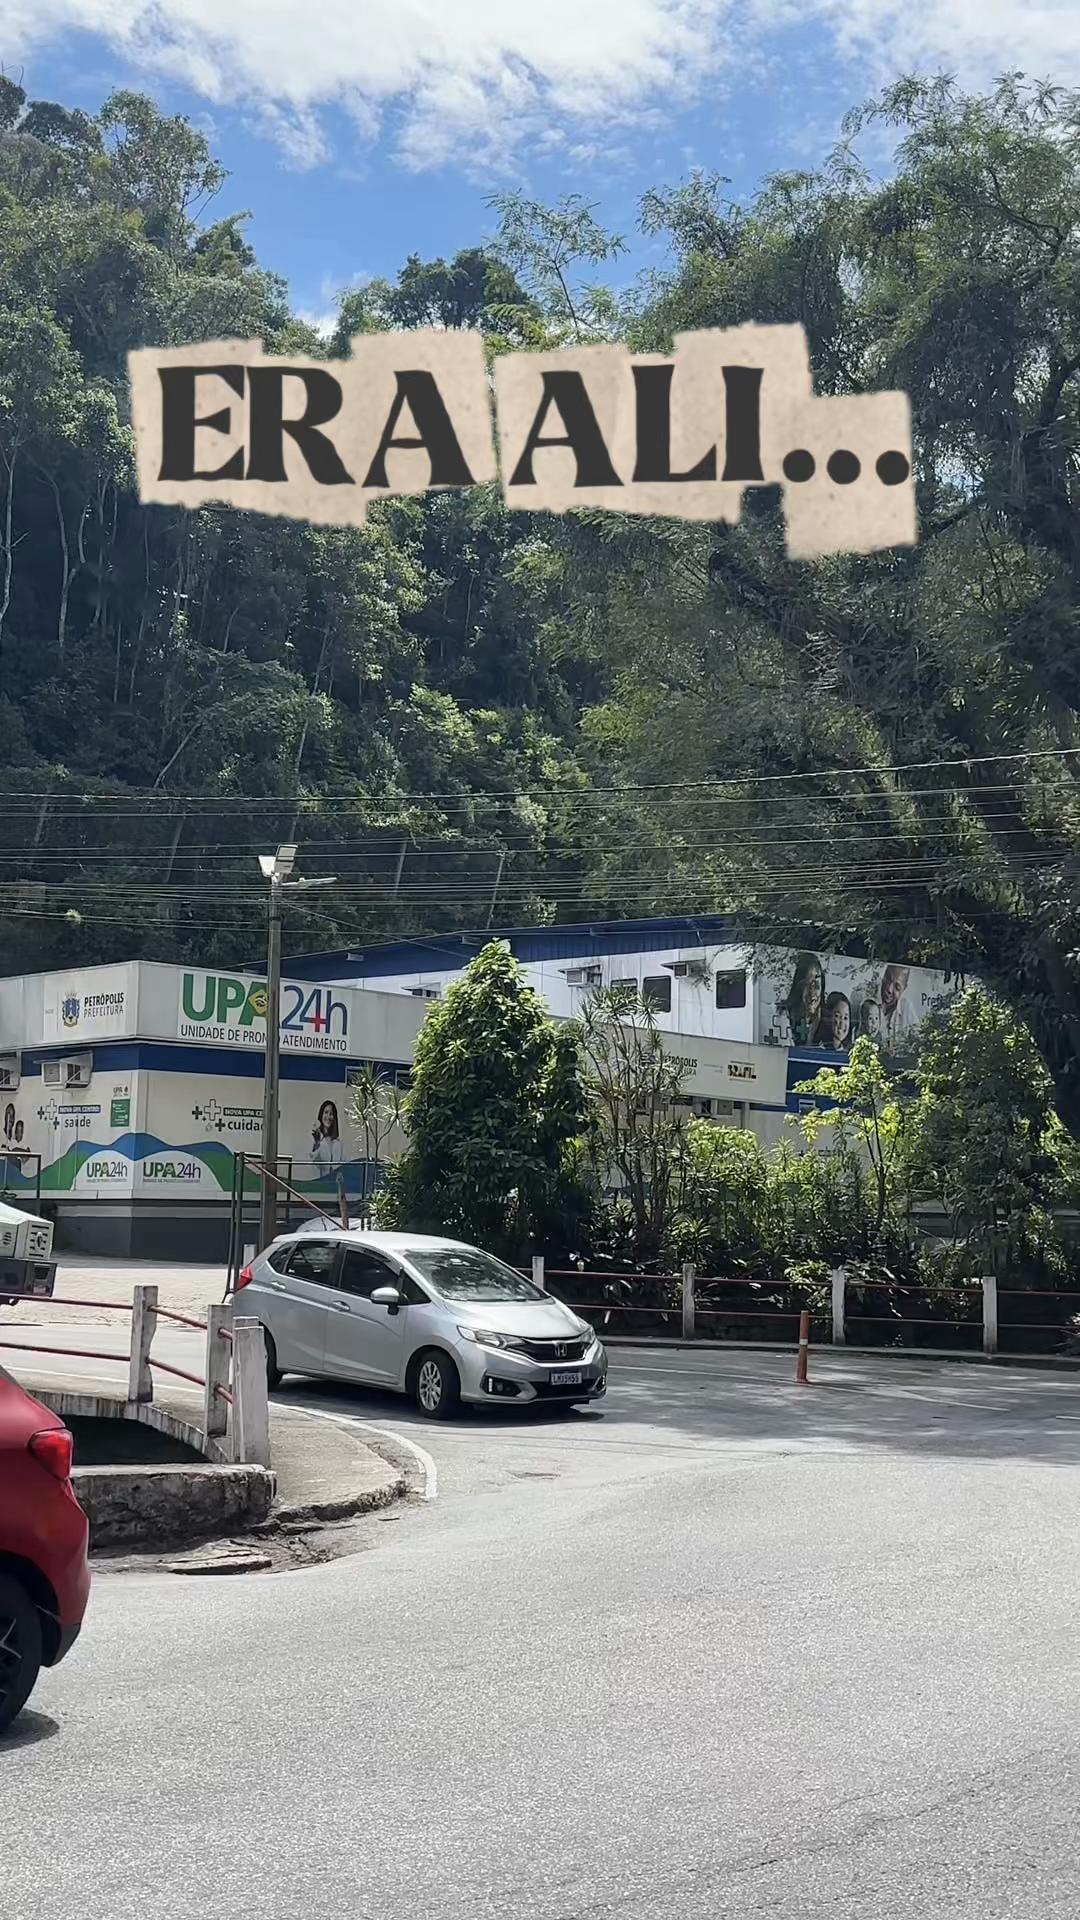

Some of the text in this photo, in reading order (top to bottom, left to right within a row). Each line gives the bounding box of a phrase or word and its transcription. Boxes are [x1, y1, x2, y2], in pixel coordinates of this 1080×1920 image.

[84, 992, 124, 1007] PETRÓPOLIS
[83, 1005, 124, 1018] PREFEITURA
[181, 1024, 225, 1040] UNIDADE
[228, 1028, 240, 1042] DE
[282, 1034, 348, 1051] ATENDIMENTO
[227, 1118, 264, 1131] cuida
